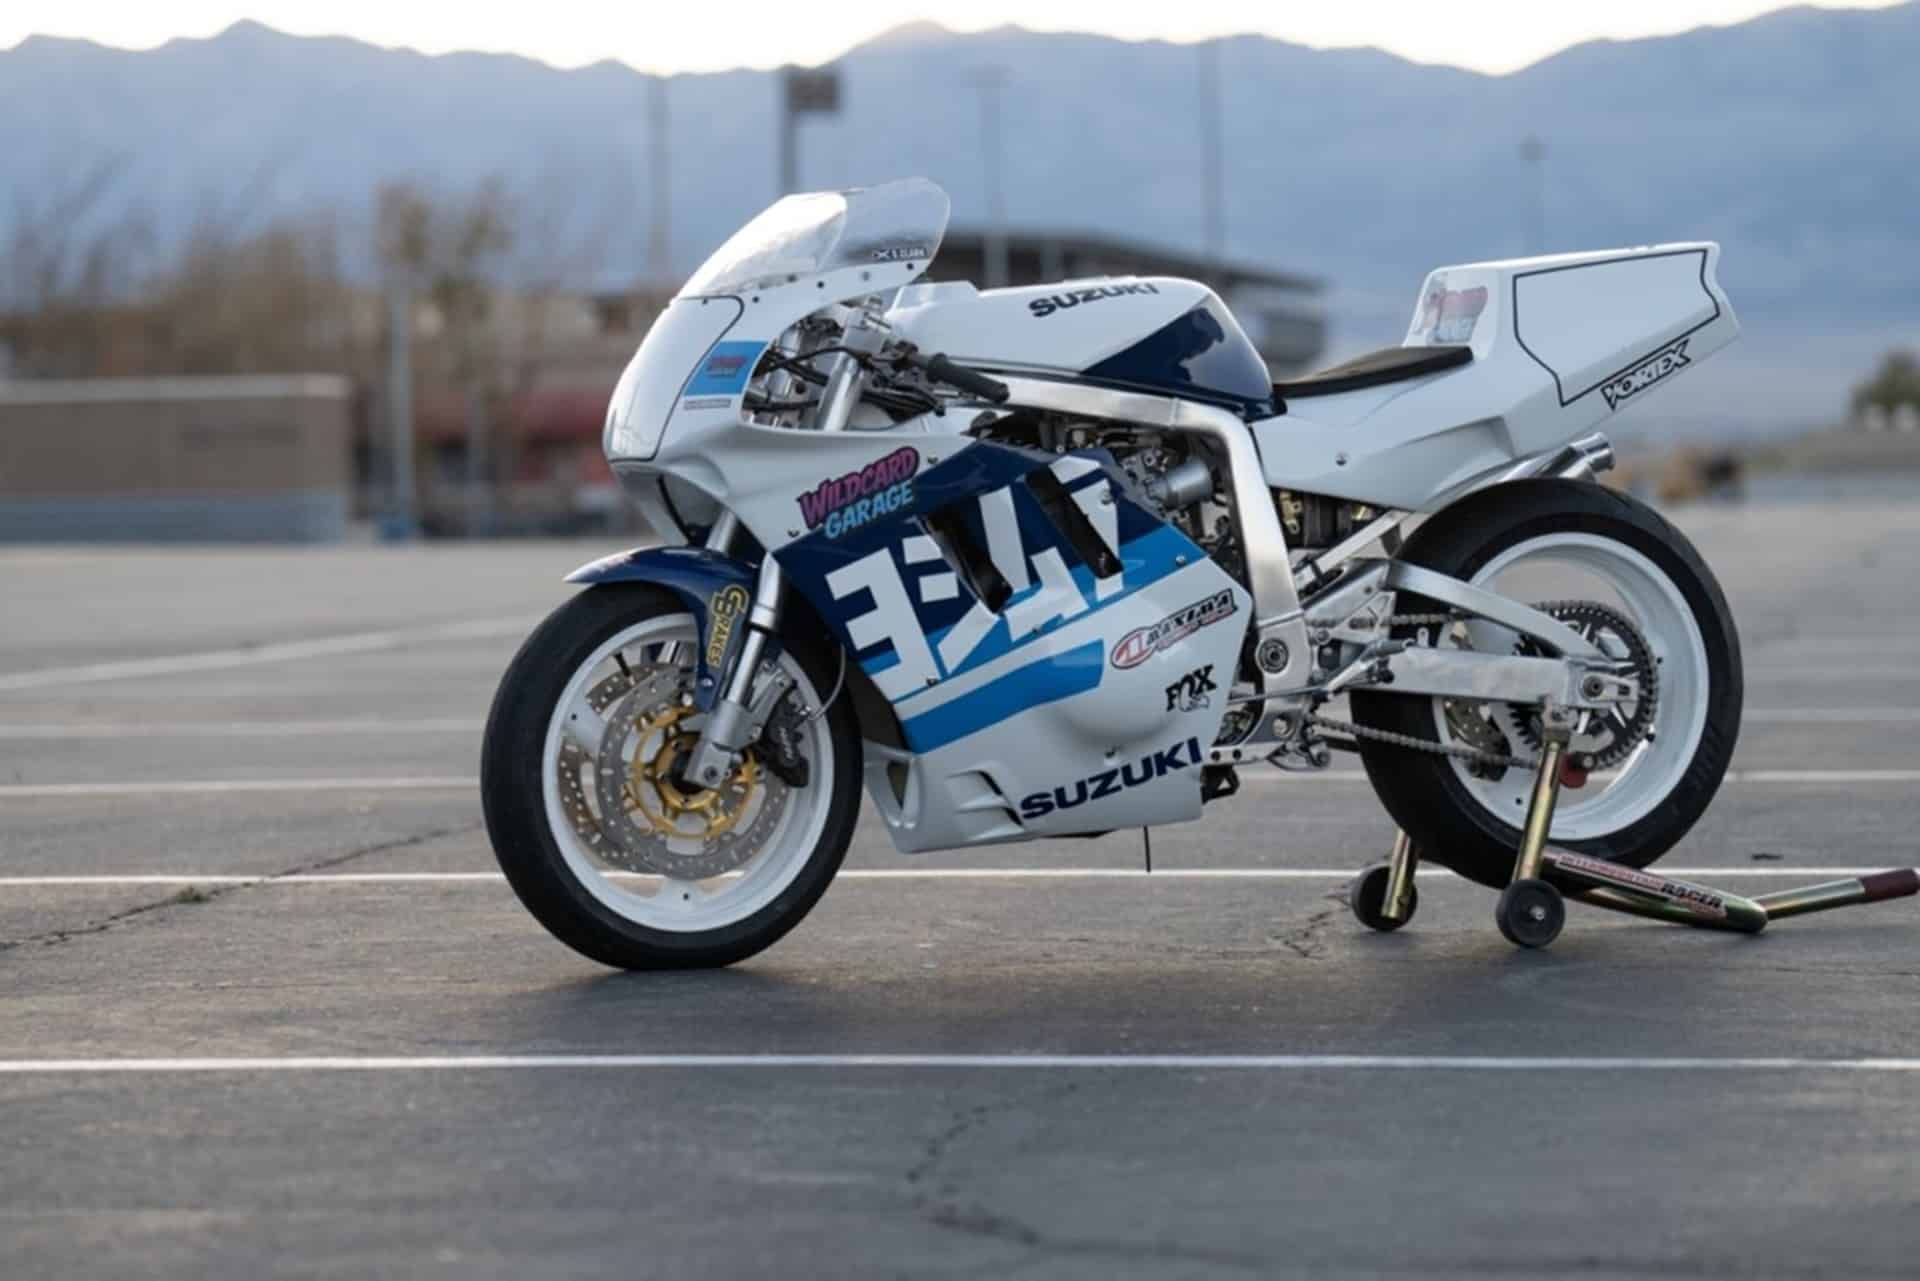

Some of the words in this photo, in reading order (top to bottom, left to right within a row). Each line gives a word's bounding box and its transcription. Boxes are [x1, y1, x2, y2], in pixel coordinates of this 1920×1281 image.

[1028, 282, 1160, 318] SUZUKI
[1600, 338, 1691, 411] VORTEX
[797, 446, 919, 529] WILDCARD
[825, 480, 914, 539] GARAGE
[1165, 664, 1217, 713] FOX
[1020, 736, 1203, 820] SUZUKI
